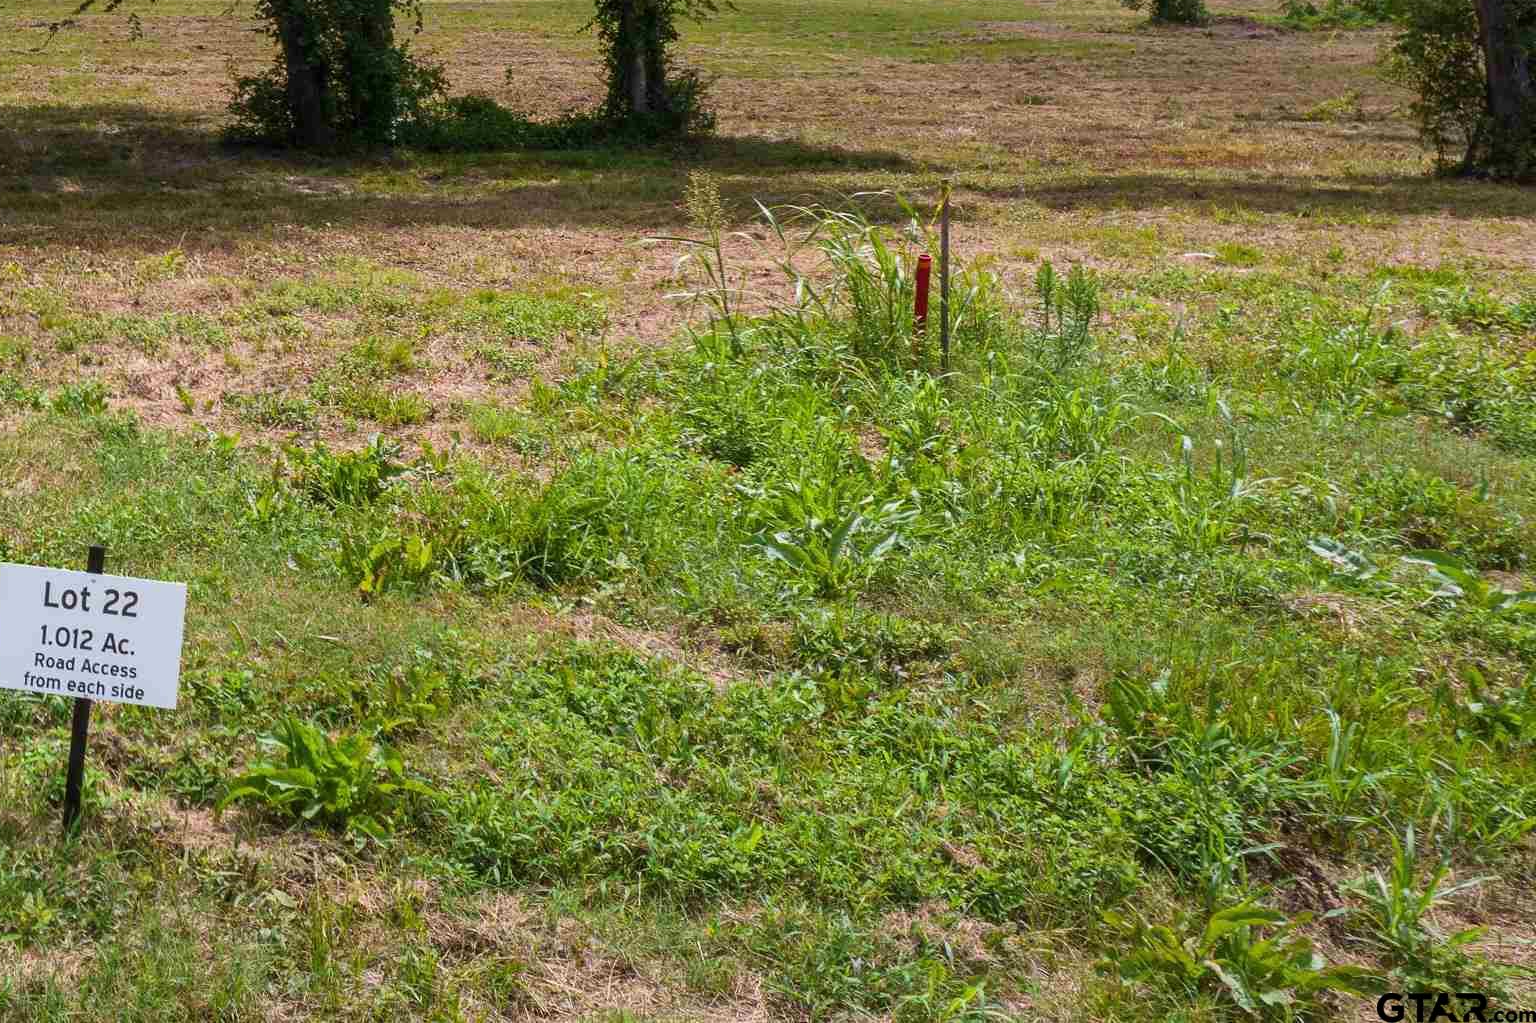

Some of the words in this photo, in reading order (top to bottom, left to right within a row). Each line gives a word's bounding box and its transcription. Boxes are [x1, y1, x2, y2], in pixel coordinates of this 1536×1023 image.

[44, 581, 90, 612] Lot
[103, 589, 139, 617] 22
[41, 625, 93, 650] 1.012
[102, 633, 135, 656] Ac.
[34, 653, 75, 671] Road
[81, 659, 137, 678] Access
[24, 672, 61, 690] from
[67, 679, 105, 696] each
[111, 684, 145, 700] side
